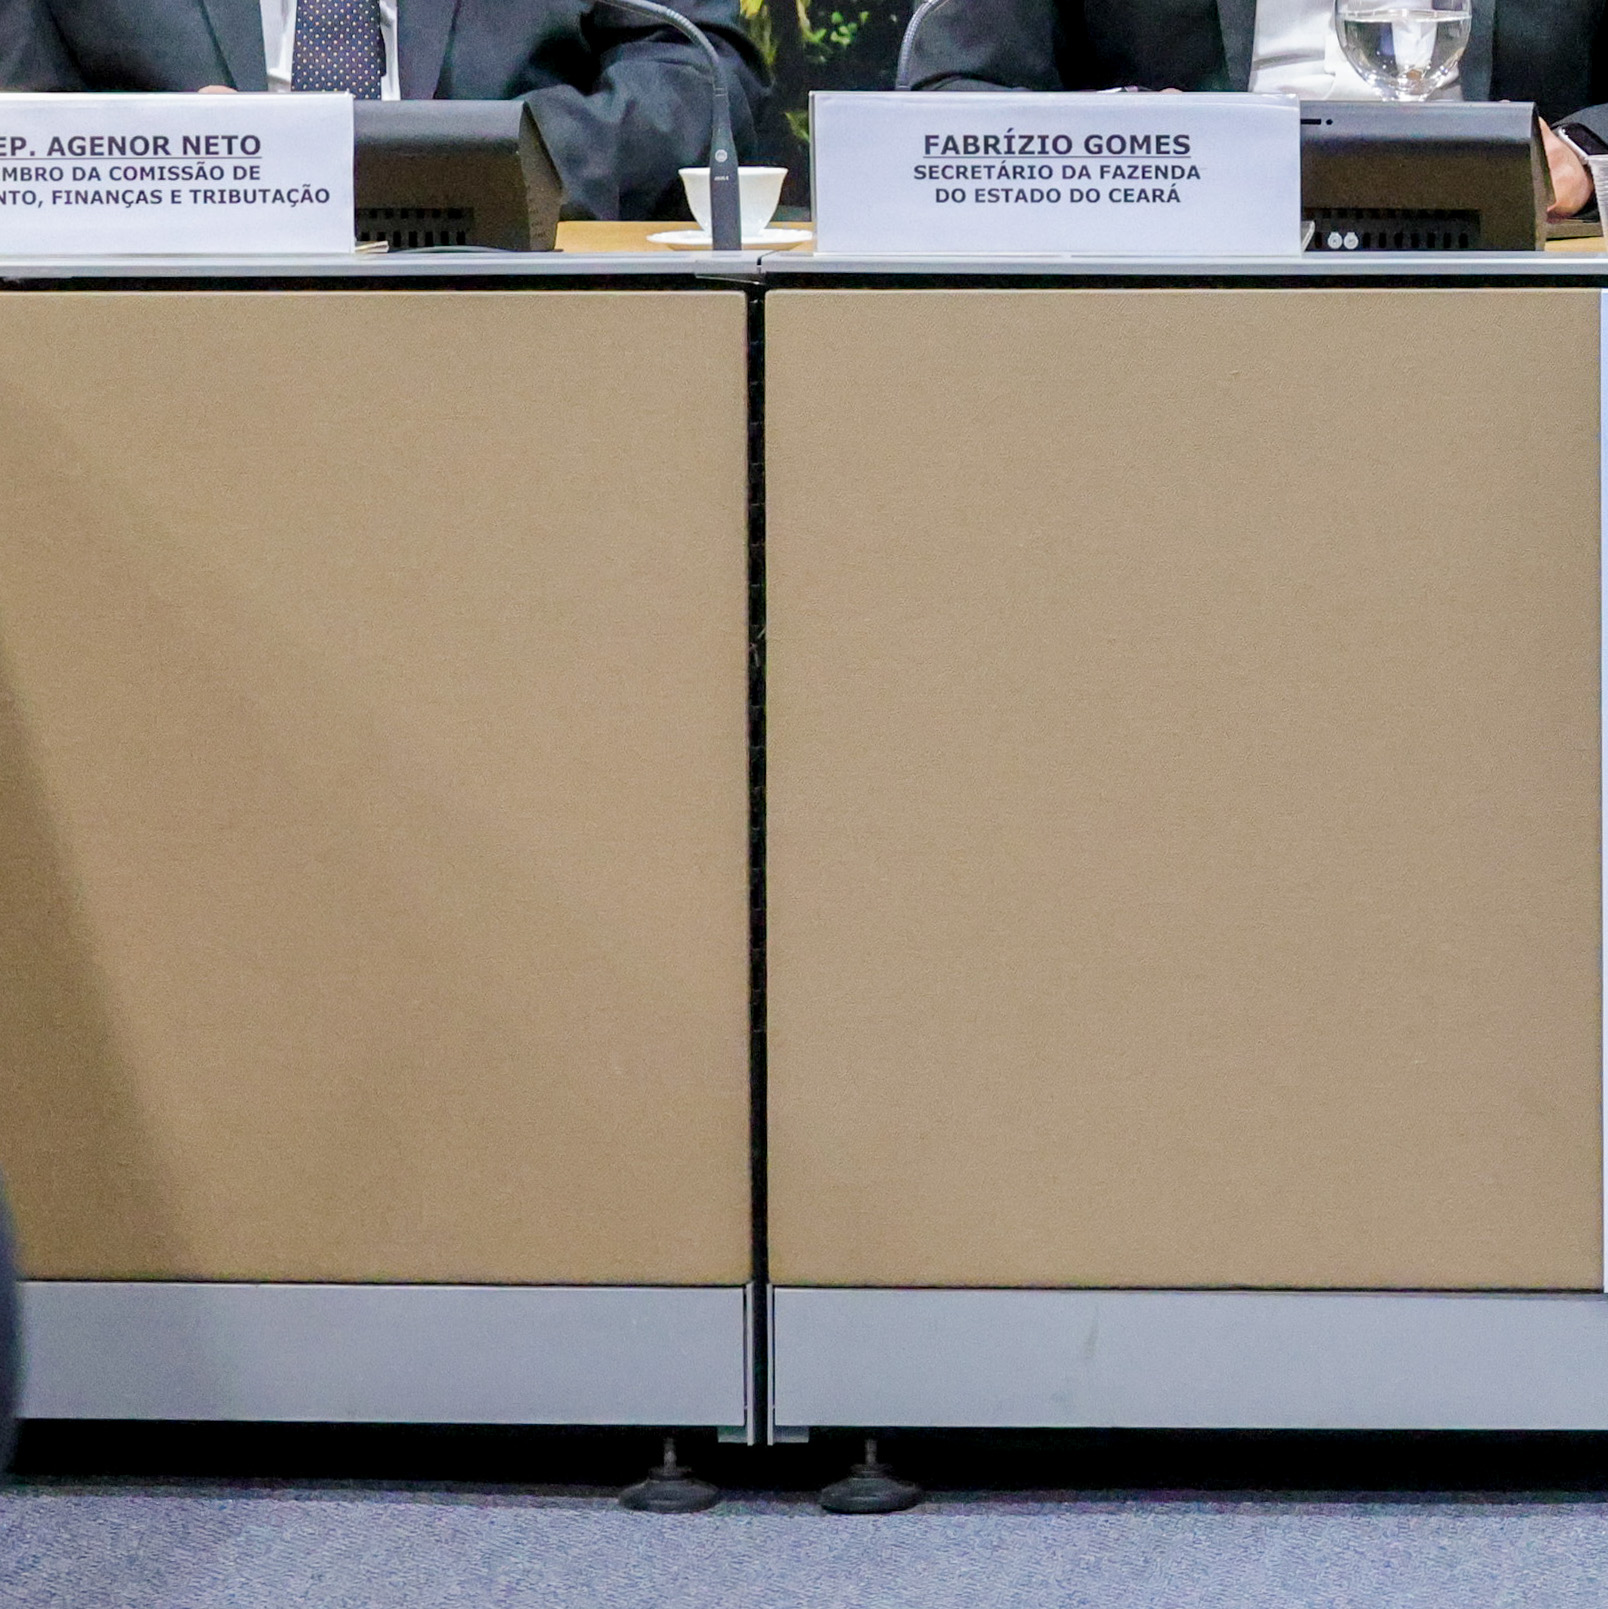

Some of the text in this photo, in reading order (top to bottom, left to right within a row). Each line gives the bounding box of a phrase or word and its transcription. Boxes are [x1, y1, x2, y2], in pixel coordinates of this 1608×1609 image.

[46, 135, 172, 157] AGENOR
[182, 134, 261, 156] NETO
[924, 127, 1191, 156] FABRÍZIO GOMES
[72, 166, 102, 182] DA
[108, 161, 225, 182] COMISSÃO
[232, 165, 261, 181] DE
[913, 159, 1201, 180] SECRETÁRIO DA FAZENDA
[51, 189, 163, 209] FINANÇAS
[170, 189, 182, 205] E
[188, 183, 330, 208] TRIBUTAÇÃO
[935, 182, 1181, 204] DO ESTADO DO CEARÁ
